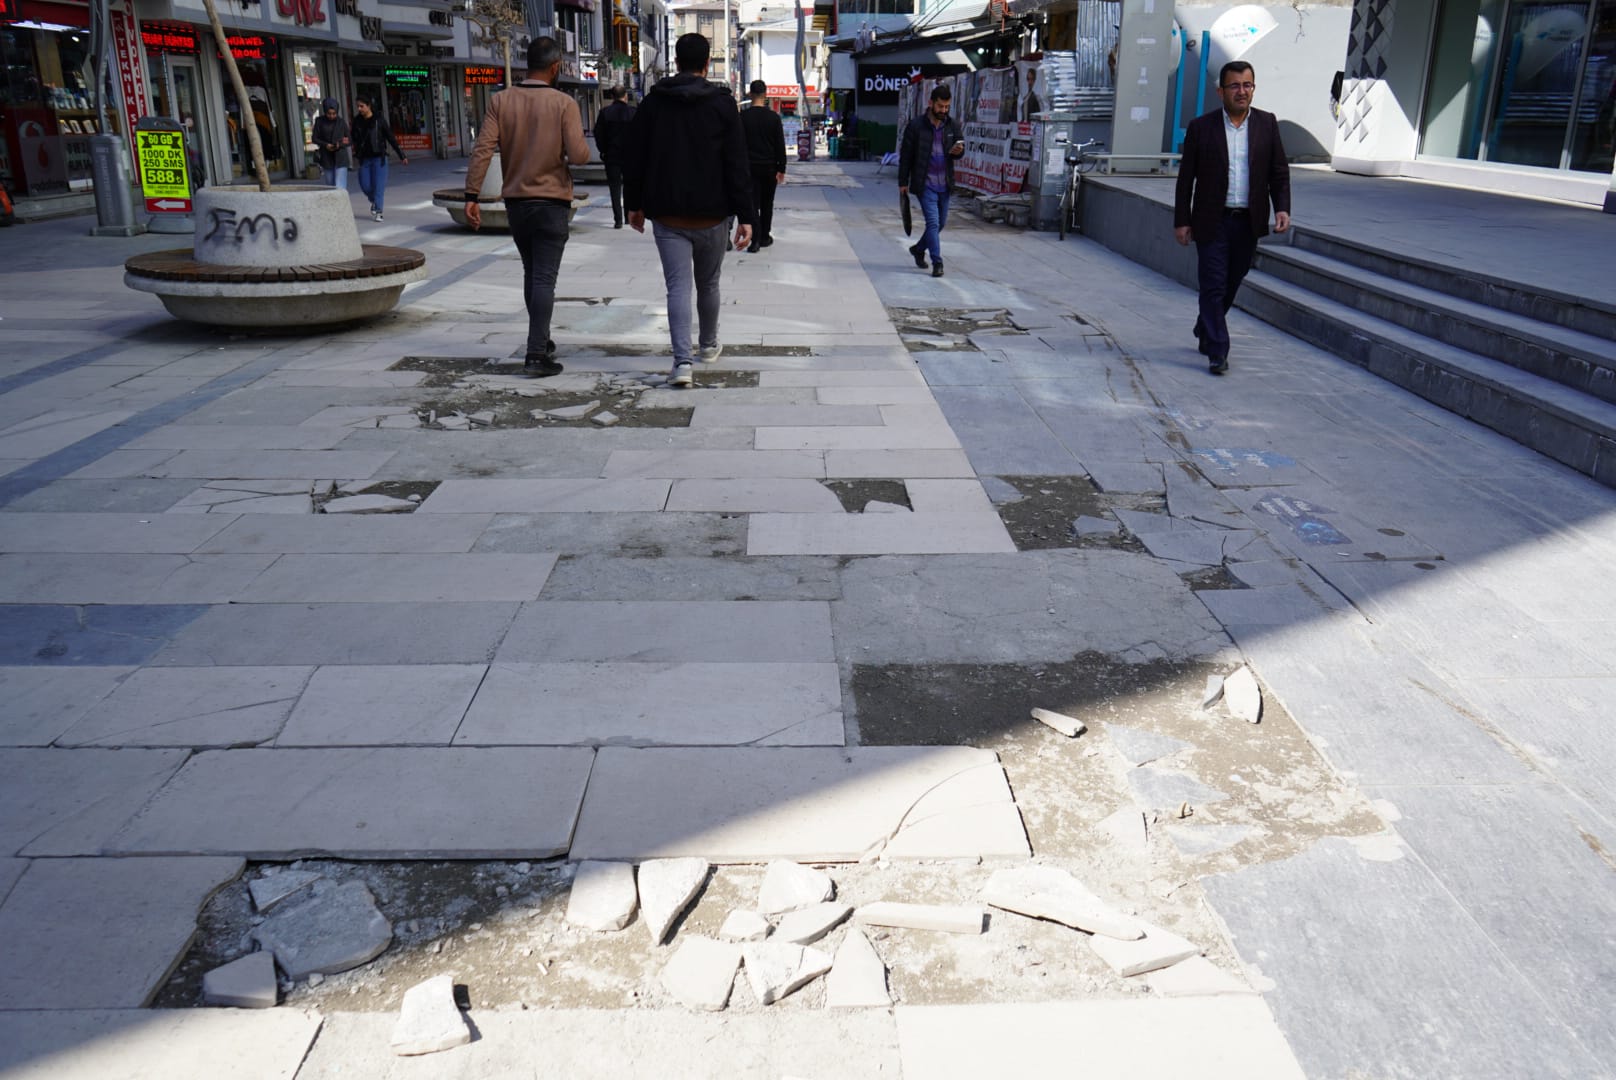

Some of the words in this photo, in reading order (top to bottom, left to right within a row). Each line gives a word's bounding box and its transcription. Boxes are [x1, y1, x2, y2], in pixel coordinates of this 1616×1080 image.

[148, 134, 158, 144] 60
[160, 134, 173, 145] GB
[142, 150, 164, 159] 1000
[168, 150, 181, 159] DK
[143, 159, 160, 167] 250
[163, 159, 184, 168] SMS
